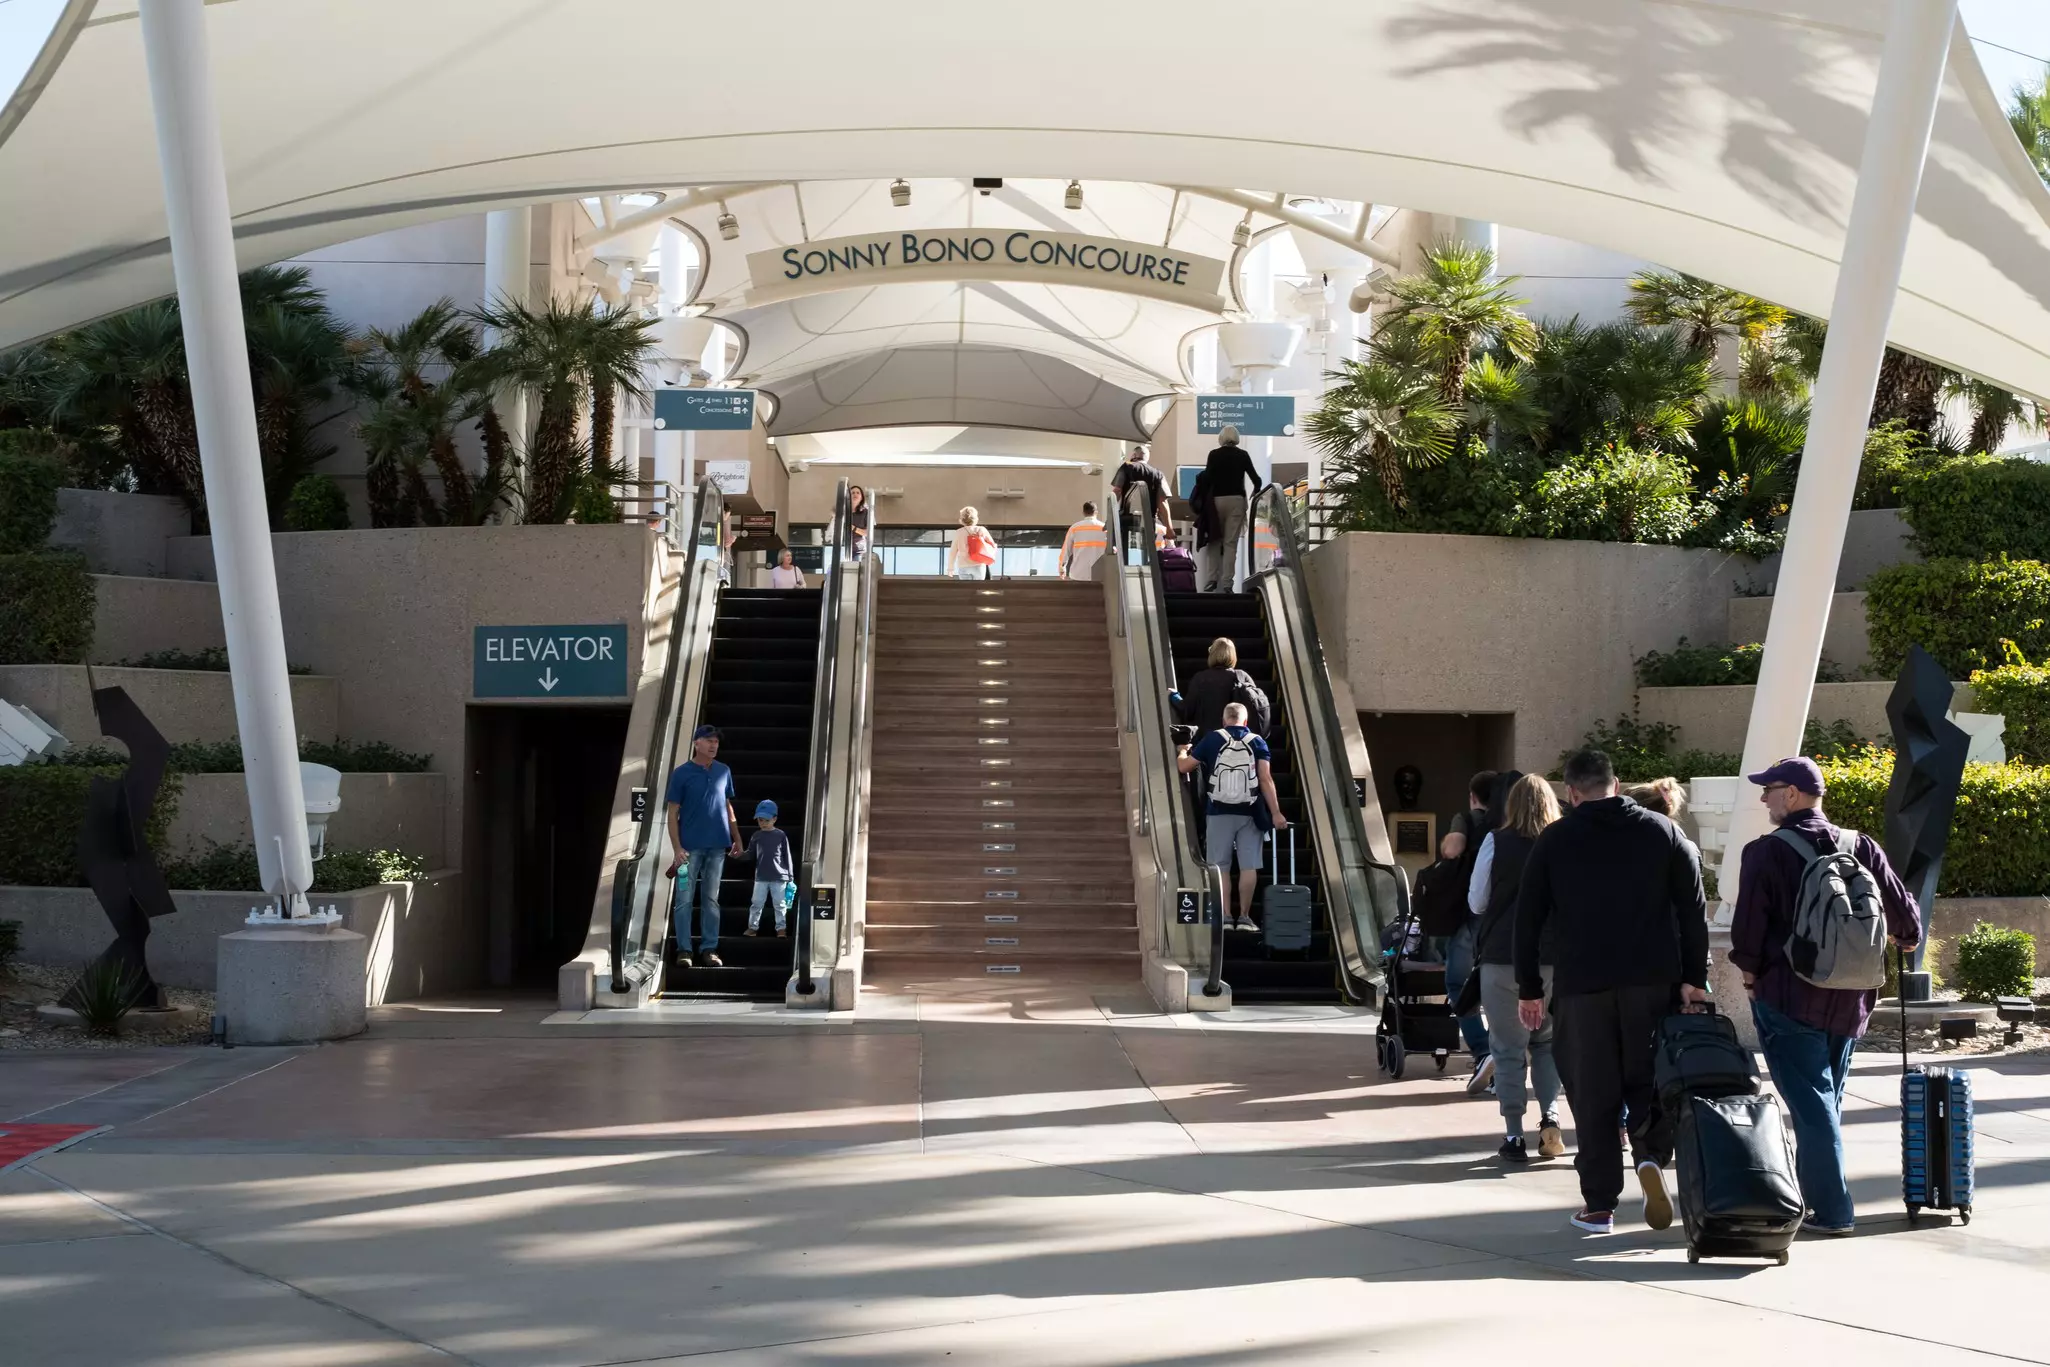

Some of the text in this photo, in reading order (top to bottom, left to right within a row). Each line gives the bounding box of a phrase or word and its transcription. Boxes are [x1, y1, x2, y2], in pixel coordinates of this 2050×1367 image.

[782, 232, 1190, 286] SONNY BONO CONCOURSE
[724, 397, 733, 405] 11
[1255, 401, 1264, 410] 11
[710, 471, 745, 482] Brighton
[486, 636, 614, 662] ELEVATOR
